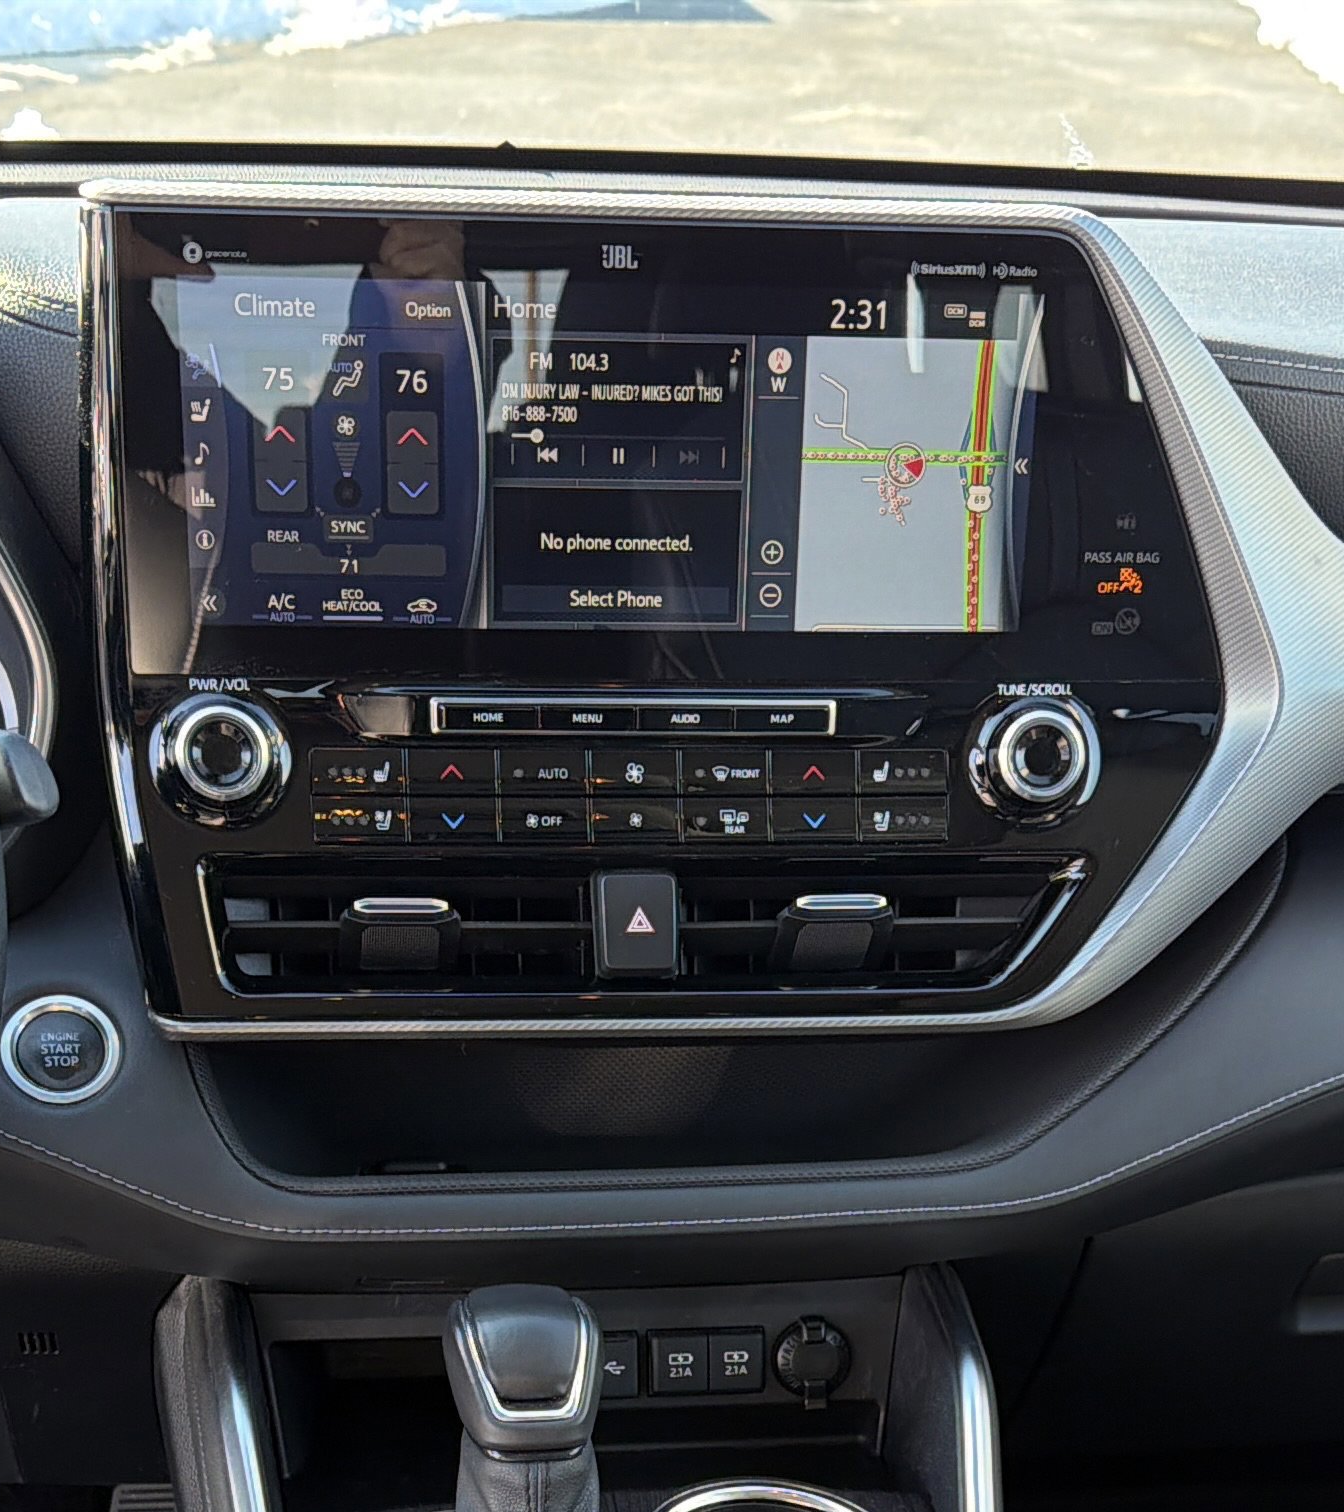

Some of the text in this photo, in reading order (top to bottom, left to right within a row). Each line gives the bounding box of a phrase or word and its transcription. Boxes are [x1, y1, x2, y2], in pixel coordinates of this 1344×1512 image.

[205, 250, 248, 259] gracenote
[601, 244, 639, 269] JBL
[1009, 265, 1038, 277] Radio
[233, 292, 316, 318] Climate
[405, 301, 452, 320] Option
[493, 296, 557, 319] Home
[829, 298, 888, 331] 2:31
[321, 333, 367, 347] FRONT
[529, 352, 609, 372] FM 104.3
[262, 367, 294, 391] 75
[395, 369, 428, 394] 76
[770, 376, 787, 393] W
[501, 382, 519, 399] DM
[521, 383, 557, 400] INJURY
[559, 384, 580, 400] LAW
[591, 385, 639, 401] INJURED?
[641, 385, 672, 402] MIKES
[674, 386, 697, 402] GOT
[698, 386, 724, 403] THIS!
[501, 406, 578, 423] 816-888-7500
[973, 495, 986, 505] 69
[330, 520, 367, 534] SYNC
[267, 530, 300, 543] REAR
[540, 533, 694, 556] No phone connected.
[1084, 551, 1161, 564] PASS AIR BAG
[339, 558, 360, 574] 71
[340, 588, 364, 600] ECO
[1097, 582, 1120, 594] OFF
[267, 592, 296, 611] A/C
[569, 590, 663, 608] Select Phone
[322, 600, 383, 613] HEAT/COOL
[269, 612, 296, 623] AUTO
[409, 613, 435, 625] AUTO
[188, 678, 250, 692] PWR/VOL
[997, 682, 1073, 698] TUNE/SCROLL
[472, 712, 504, 723] HOME
[572, 713, 604, 724] MENU
[670, 713, 701, 725] AUDIO
[769, 713, 795, 724] MAP
[537, 767, 569, 780] AUTO
[730, 768, 760, 780] FRONT
[541, 815, 563, 828] OFF
[724, 823, 745, 835] REAR
[40, 1032, 80, 1042] ENGINE
[40, 1043, 81, 1055] START
[44, 1055, 80, 1068] STOP
[669, 1366, 693, 1379] 2.1A
[724, 1364, 748, 1377] 2.1A
